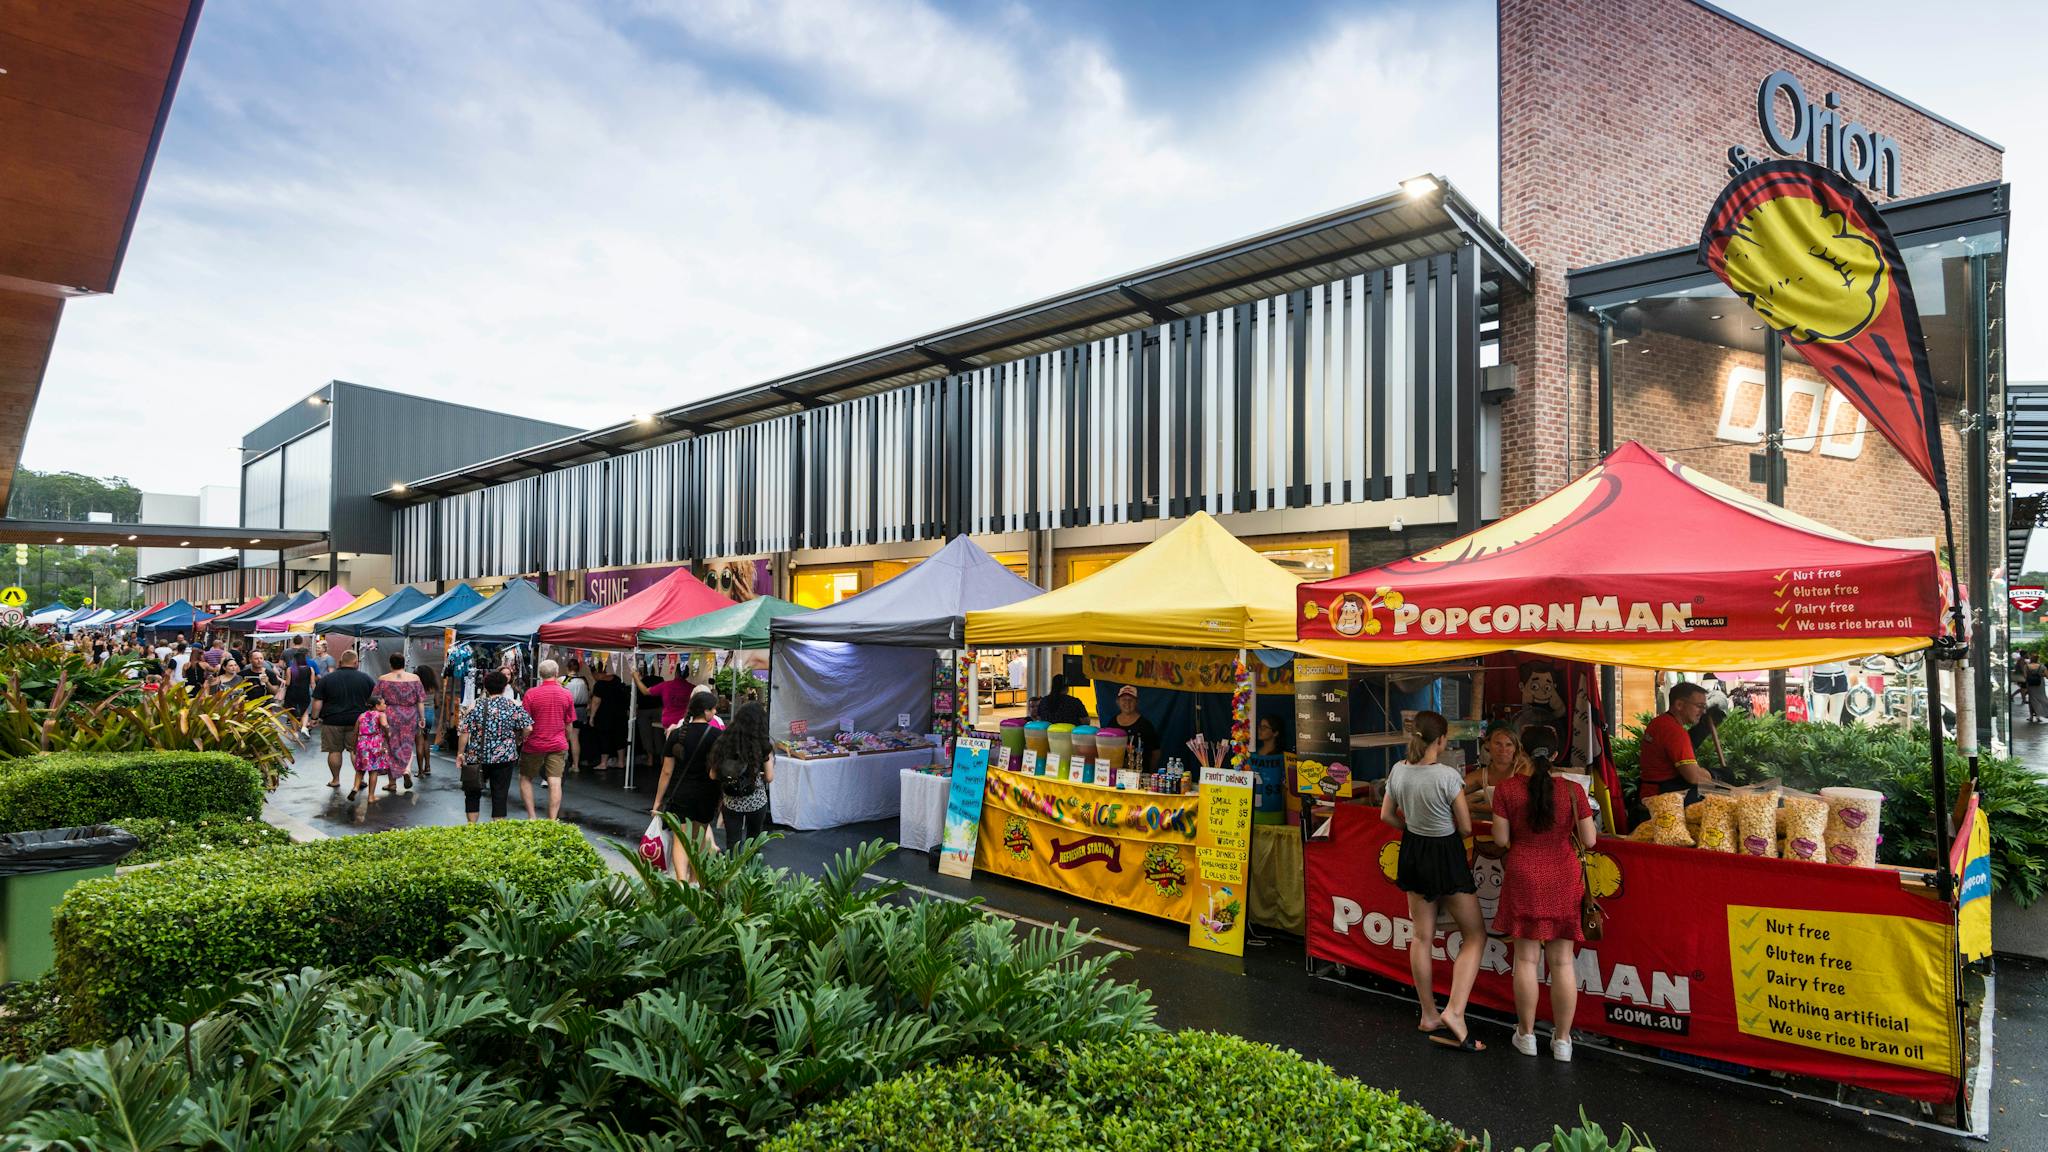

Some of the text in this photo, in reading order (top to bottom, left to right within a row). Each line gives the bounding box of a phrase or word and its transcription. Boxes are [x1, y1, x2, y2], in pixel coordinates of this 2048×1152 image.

[1757, 70, 1900, 198] Orion
[1793, 569, 1842, 581] Nut free
[1793, 584, 1860, 597] Gluten free
[1794, 602, 1855, 615] Dairy free
[8, 613, 18, 621] 10
[1796, 617, 1912, 631] We use rice bran oil
[1089, 654, 1133, 675] FRUIT
[1205, 772, 1248, 785] FRUIT DRINKS
[1210, 807, 1249, 818] Large $5
[1093, 802, 1121, 826] ICE
[1125, 804, 1197, 839] BLOCKS
[1209, 817, 1223, 826] Yard
[1087, 842, 1114, 859] STATION
[1237, 840, 1246, 848] $3
[1239, 853, 1247, 861] $3
[1229, 863, 1238, 871] $2
[1766, 918, 1831, 941] Nut free
[1766, 945, 1853, 971] Gluten free
[1767, 969, 1846, 995] Dairy free
[1609, 1007, 1682, 1031] .com.au
[1768, 995, 1909, 1033] Nothing artificial
[1769, 1019, 1924, 1060] We use rice bran oil
